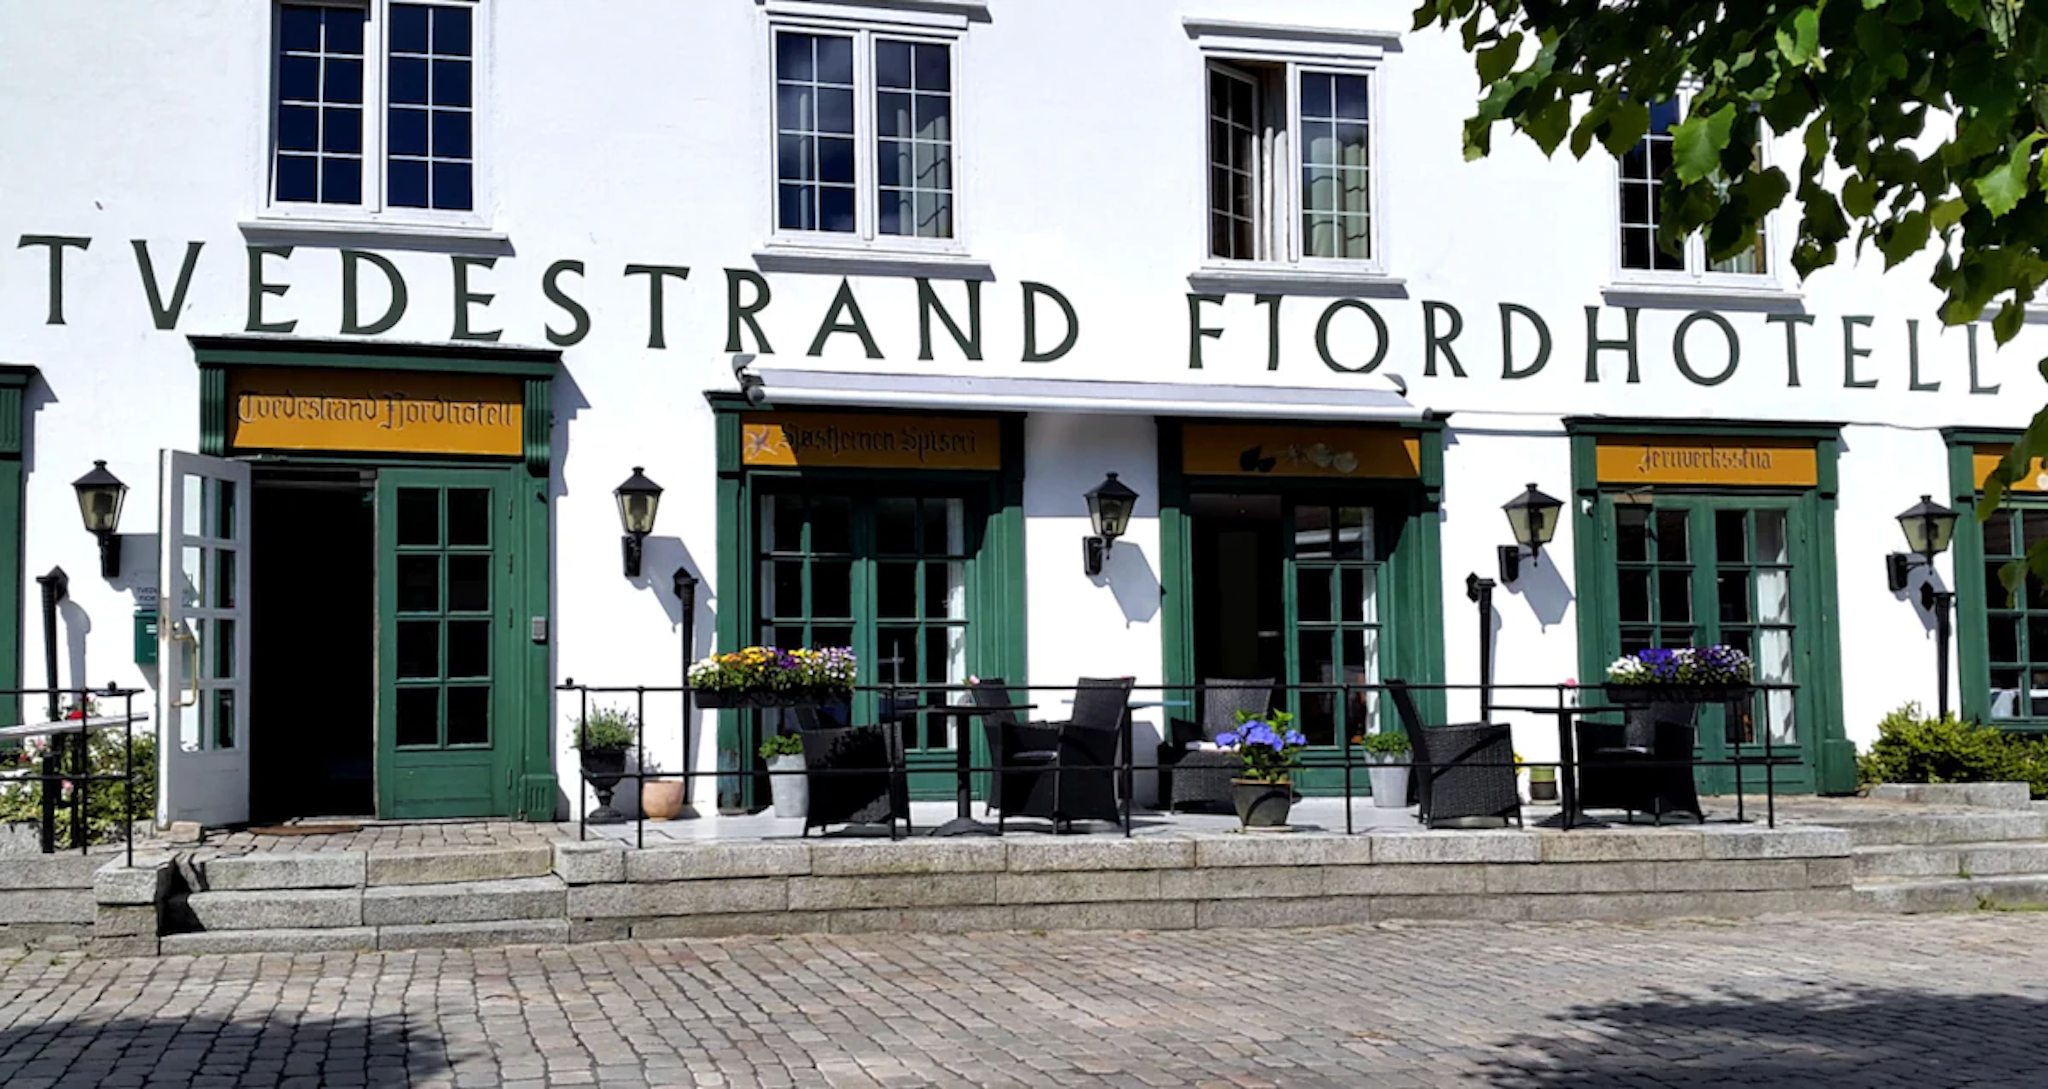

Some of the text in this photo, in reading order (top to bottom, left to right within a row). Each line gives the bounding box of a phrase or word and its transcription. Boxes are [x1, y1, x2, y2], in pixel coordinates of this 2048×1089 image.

[17, 234, 2001, 395] TVEDESTRAND FJORDHOTELL
[236, 390, 514, 430] Tvedestrand Fjordhotell
[899, 424, 978, 463] Spiseri
[1638, 445, 1772, 473] Jernverksstua
